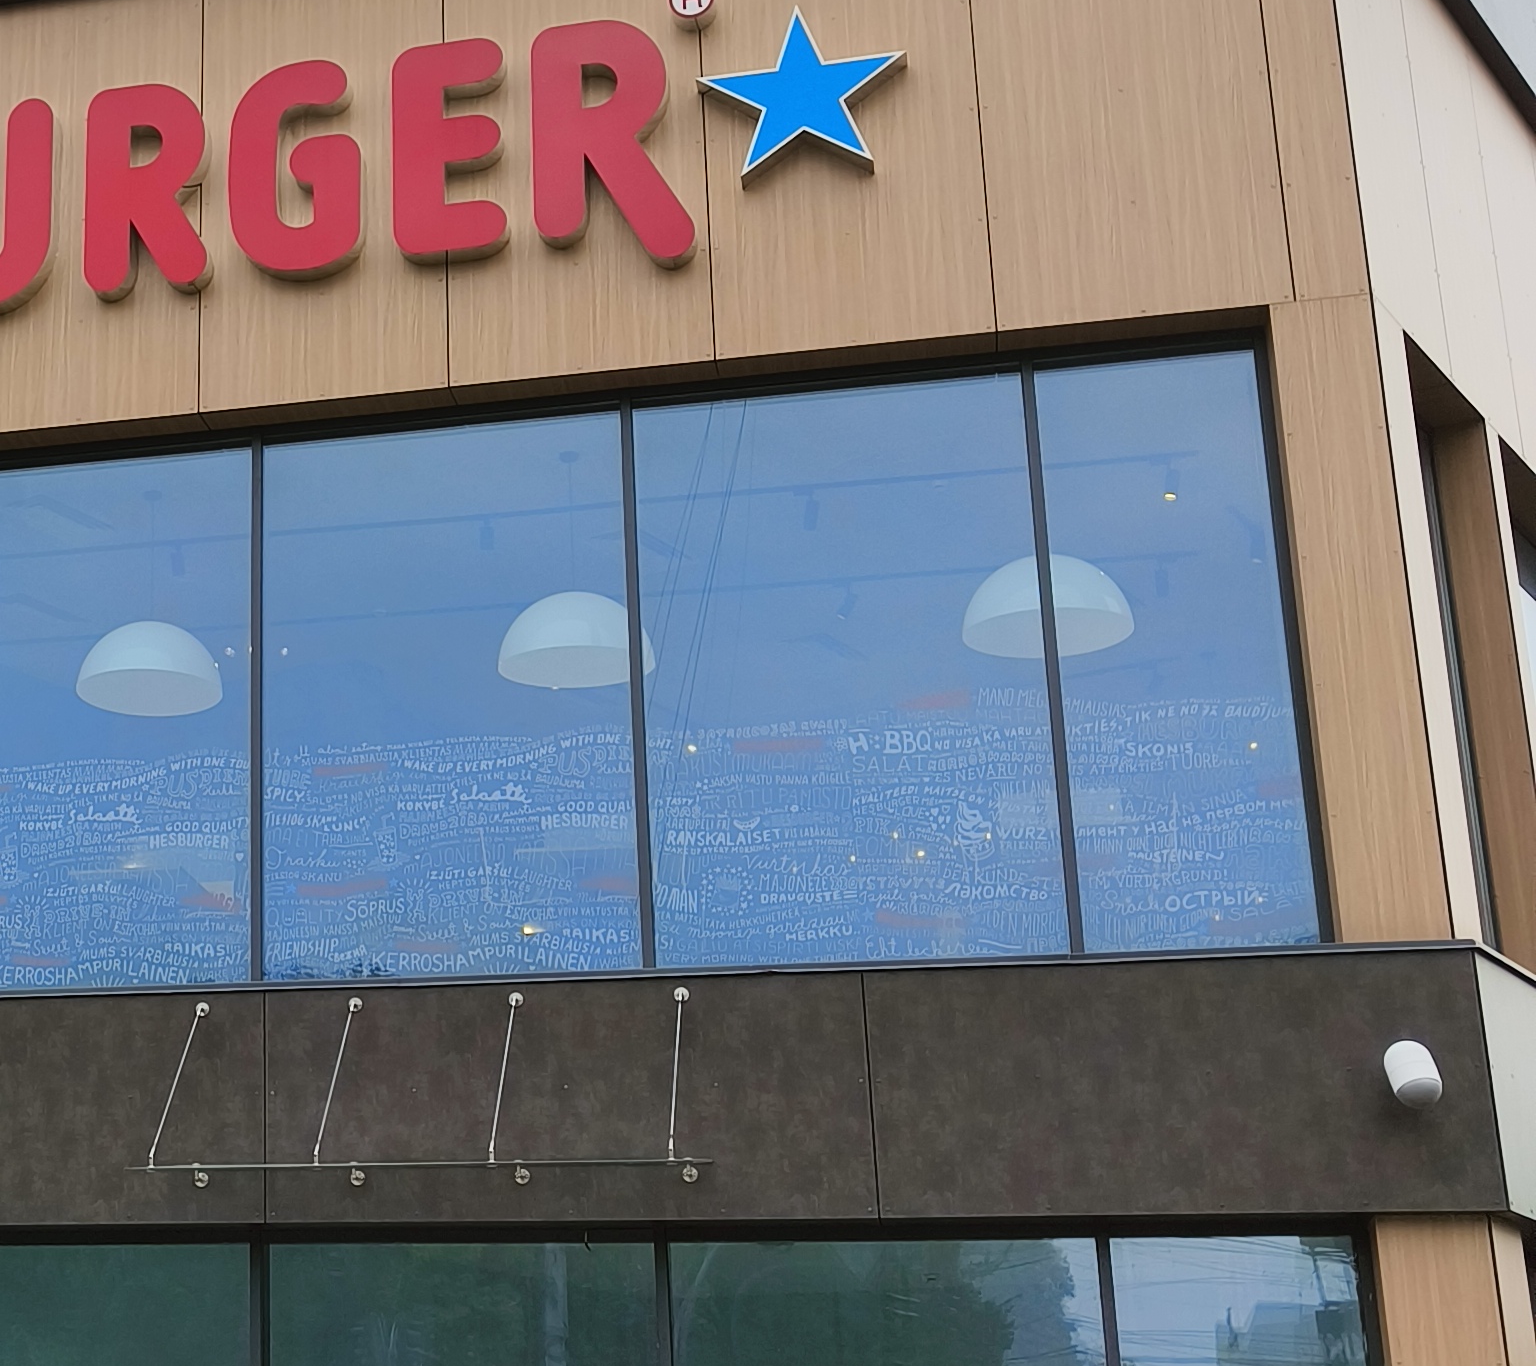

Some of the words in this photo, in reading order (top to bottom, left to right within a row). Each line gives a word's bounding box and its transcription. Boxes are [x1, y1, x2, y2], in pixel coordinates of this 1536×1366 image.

[883, 730, 932, 754] BBQ
[1124, 742, 1194, 757] SKONIS
[404, 758, 434, 774] WAKE
[437, 759, 452, 774] UP
[456, 757, 493, 774] EVERY
[497, 742, 557, 769] MORNING
[560, 734, 593, 750] WITH
[597, 733, 622, 746] ONE
[27, 781, 55, 795] WAKE
[58, 781, 72, 794] UP
[74, 781, 109, 794] EVERY
[111, 766, 167, 790] MORNING
[170, 760, 202, 776] WITH
[205, 756, 227, 771] ONE
[557, 800, 595, 813] GOOD
[598, 799, 633, 814] QUAL
[165, 820, 199, 834] GOOD
[541, 812, 629, 831] HESBURGER
[150, 834, 229, 850] HESBURGER
[667, 828, 782, 848] RANSKALAISET
[344, 897, 405, 922] SÕPRUS
[469, 931, 510, 948] MUMS
[79, 944, 116, 962] MUMS
[265, 937, 339, 963] FRIENDSHIP
[371, 943, 591, 976] KERROSHAMPURILAINEN
